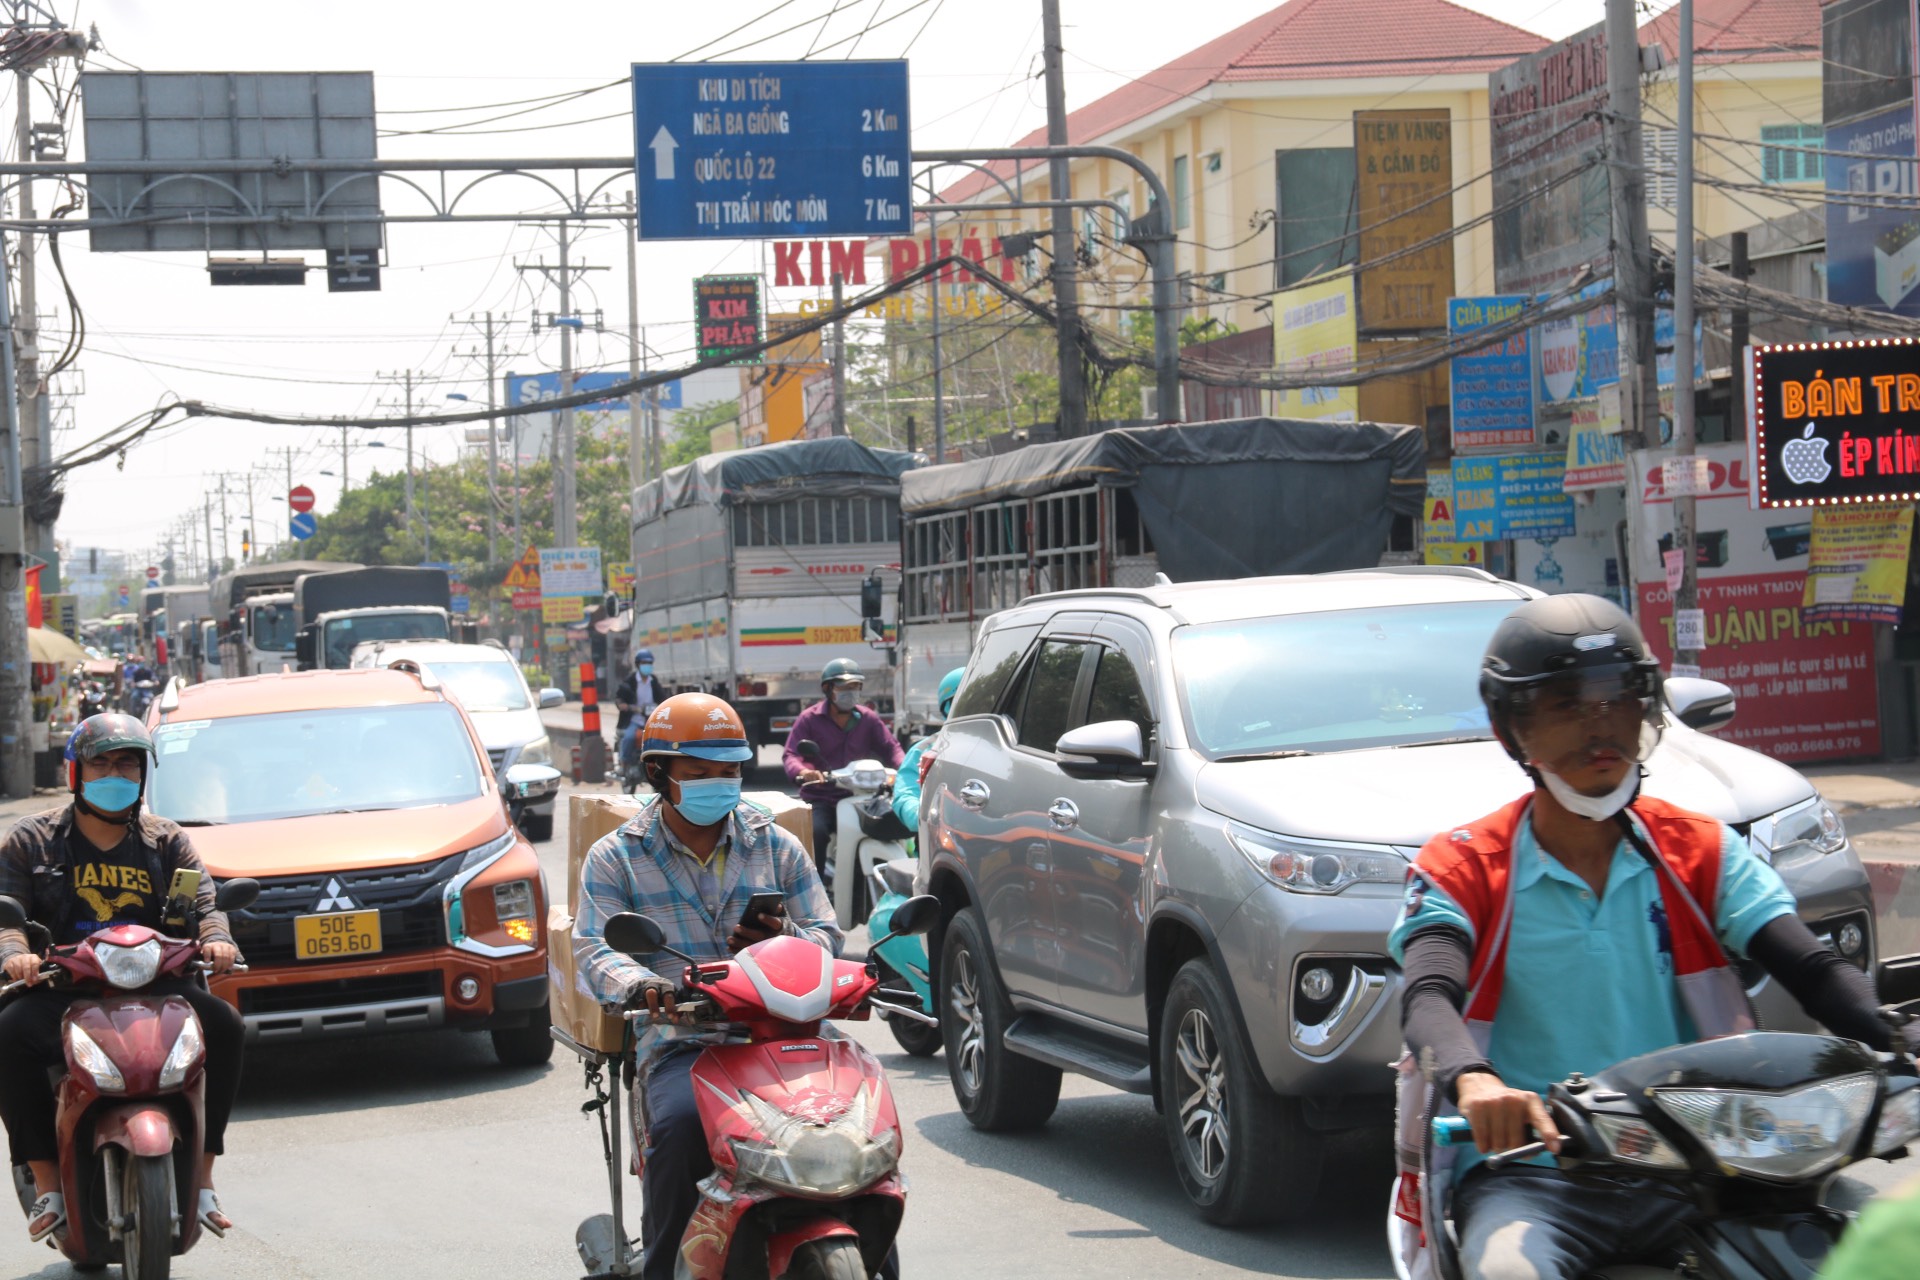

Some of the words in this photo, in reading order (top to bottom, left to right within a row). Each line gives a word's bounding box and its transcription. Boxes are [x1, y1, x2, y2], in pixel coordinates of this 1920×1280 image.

[699, 79, 728, 101] KHU
[731, 79, 746, 100] DI
[749, 72, 781, 100] TÍCH
[693, 108, 722, 135] NGÃ
[725, 113, 744, 134] BA
[747, 104, 790, 134] GIỒNG
[861, 109, 872, 132] 2
[874, 109, 898, 131] Km
[1361, 121, 1399, 146] TIỆM
[1404, 118, 1443, 142] VÀNG
[1849, 132, 1872, 154] CÔNG
[1873, 130, 1884, 149] TY
[695, 148, 732, 183] QUỐC
[736, 151, 753, 185] LỘ
[757, 157, 776, 179] 22
[862, 155, 872, 177] 6
[875, 155, 899, 177] Km
[1366, 157, 1378, 174] &
[1382, 148, 1416, 173] CẦM
[1420, 145, 1441, 173] ĐỒ
[696, 202, 720, 229] THỊ
[723, 191, 760, 223] TRẤN
[764, 195, 791, 222] HÓC
[796, 195, 828, 221] MÔN
[864, 200, 874, 220] 7
[877, 199, 900, 220] Km
[1377, 183, 1437, 219] KIM
[772, 240, 867, 287] KIM
[708, 298, 747, 319] KIM
[1456, 300, 1483, 326] CỬA
[1486, 300, 1523, 325] HÀNG
[702, 320, 755, 347] PHÁT
[1781, 369, 1862, 419] BÁN
[1839, 431, 1872, 477] ÉP
[1461, 520, 1494, 538] AN
[807, 564, 865, 574] HINO
[1717, 583, 1759, 597] TNHH
[1762, 579, 1804, 594] TMDV
[813, 629, 862, 643] 51D-770.7
[1660, 606, 1767, 649] TUẬN
[1678, 621, 1698, 634] 280
[1800, 657, 1822, 673] QUY
[703, 722, 737, 732] AhaMove
[319, 915, 356, 935] 50E
[306, 933, 372, 955] 069.60
[780, 1043, 819, 1052] HONDA
